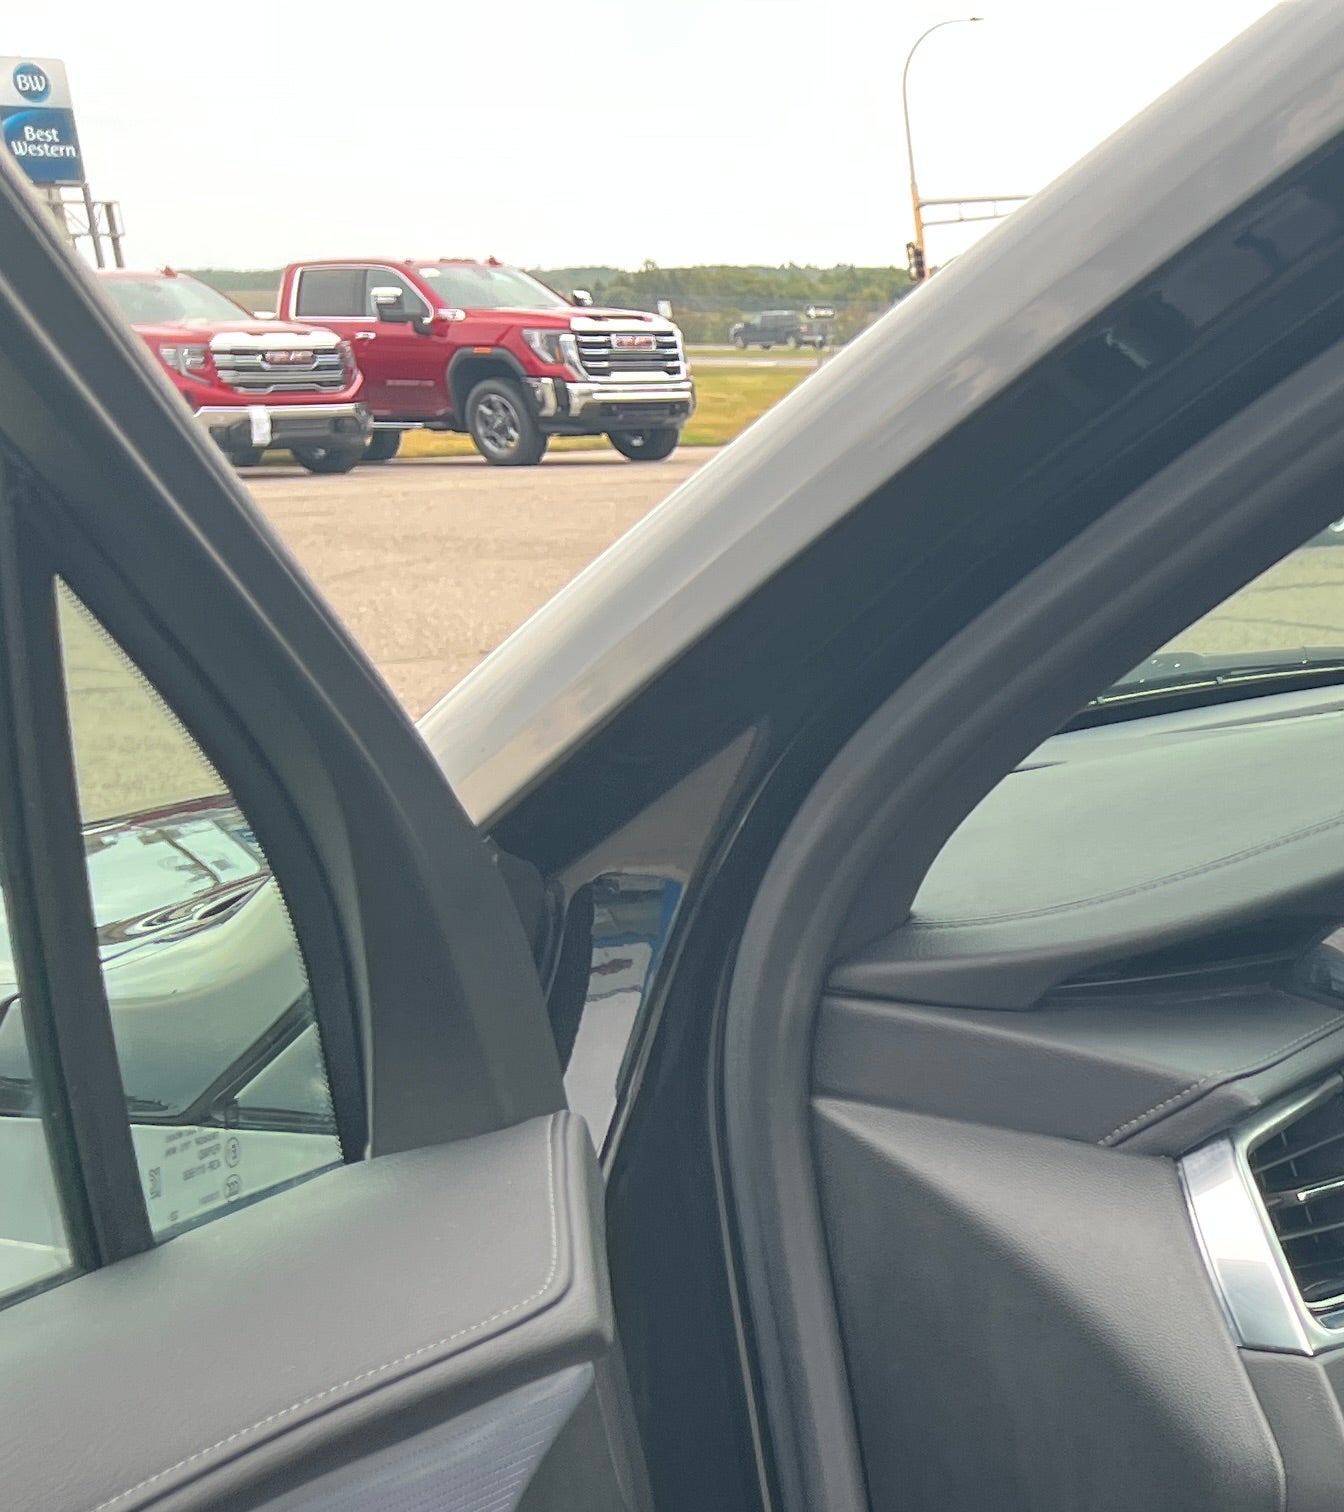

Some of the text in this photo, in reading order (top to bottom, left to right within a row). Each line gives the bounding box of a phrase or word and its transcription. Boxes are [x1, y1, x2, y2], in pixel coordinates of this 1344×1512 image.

[16, 74, 46, 92] BW
[23, 125, 60, 142] Best
[11, 140, 77, 157] Western
